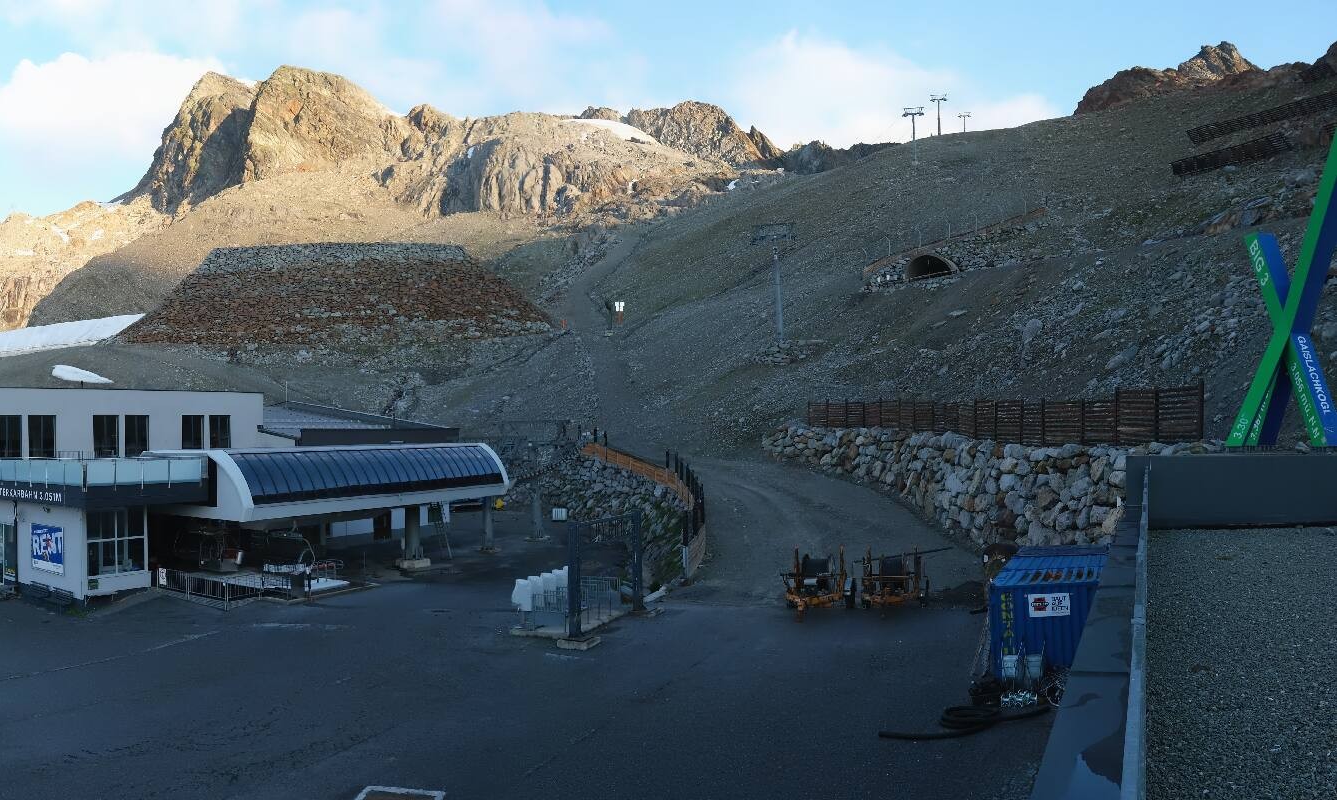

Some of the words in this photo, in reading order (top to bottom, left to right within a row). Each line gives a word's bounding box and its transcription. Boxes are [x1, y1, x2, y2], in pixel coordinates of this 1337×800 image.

[1249, 238, 1265, 273] BIG
[1260, 273, 1269, 286] 3
[1297, 335, 1331, 415] GAISLACHKOGL
[32, 532, 62, 556] RENT
